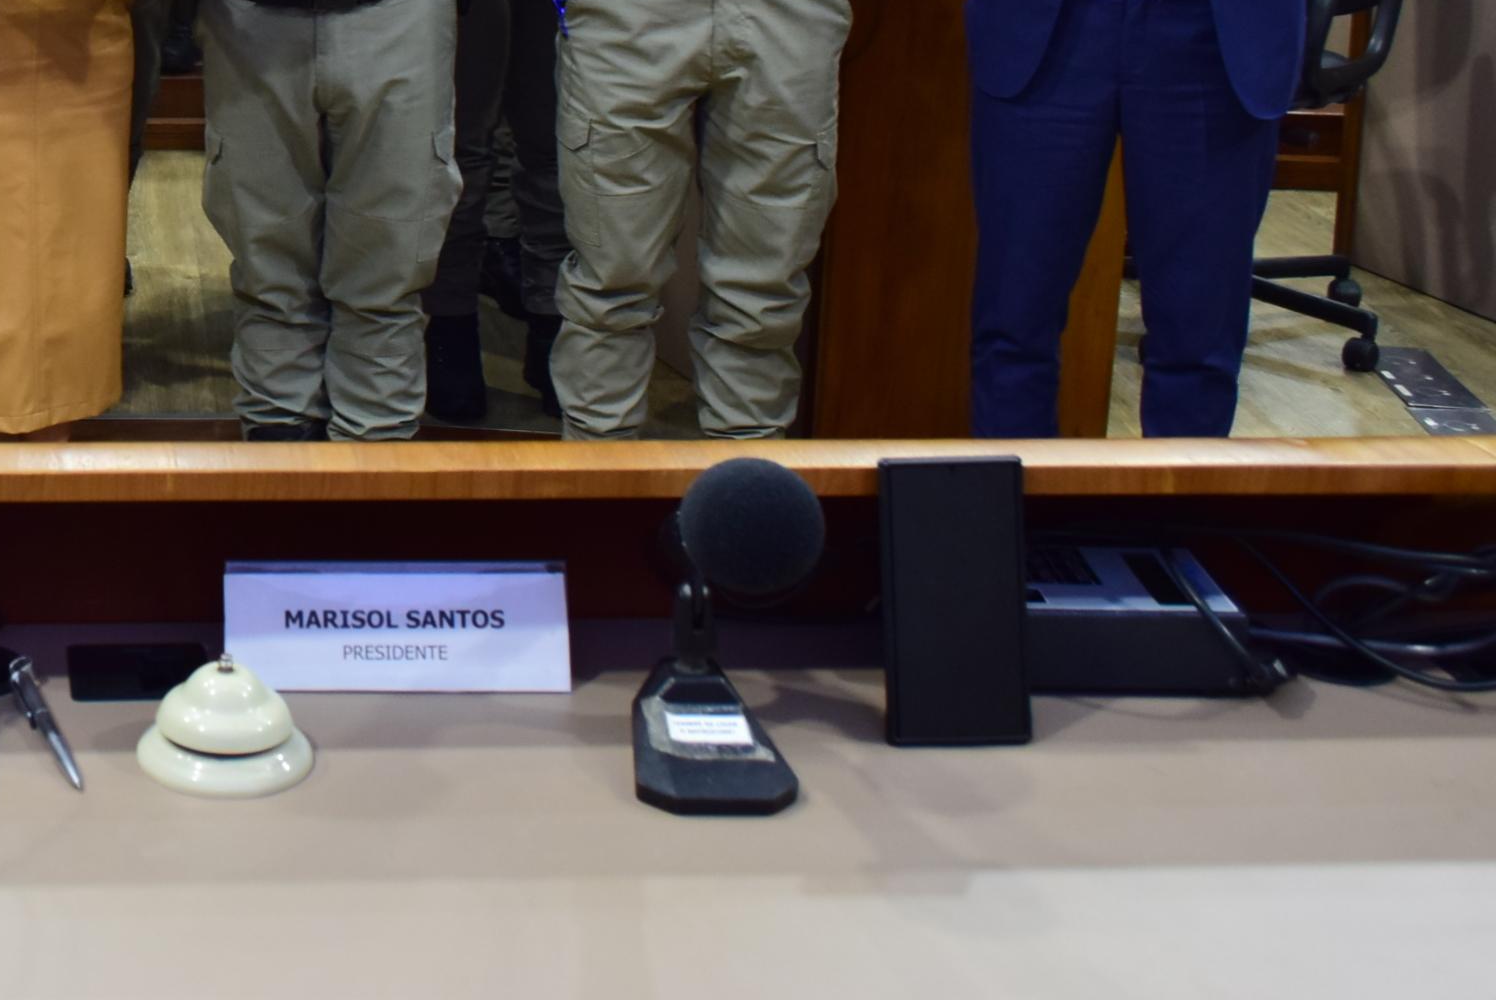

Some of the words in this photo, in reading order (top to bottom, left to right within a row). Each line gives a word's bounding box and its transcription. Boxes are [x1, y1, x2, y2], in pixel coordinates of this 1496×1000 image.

[284, 609, 400, 629] MARISOL
[406, 609, 505, 629] SANTOS
[343, 644, 449, 661] PRESIDENTE
